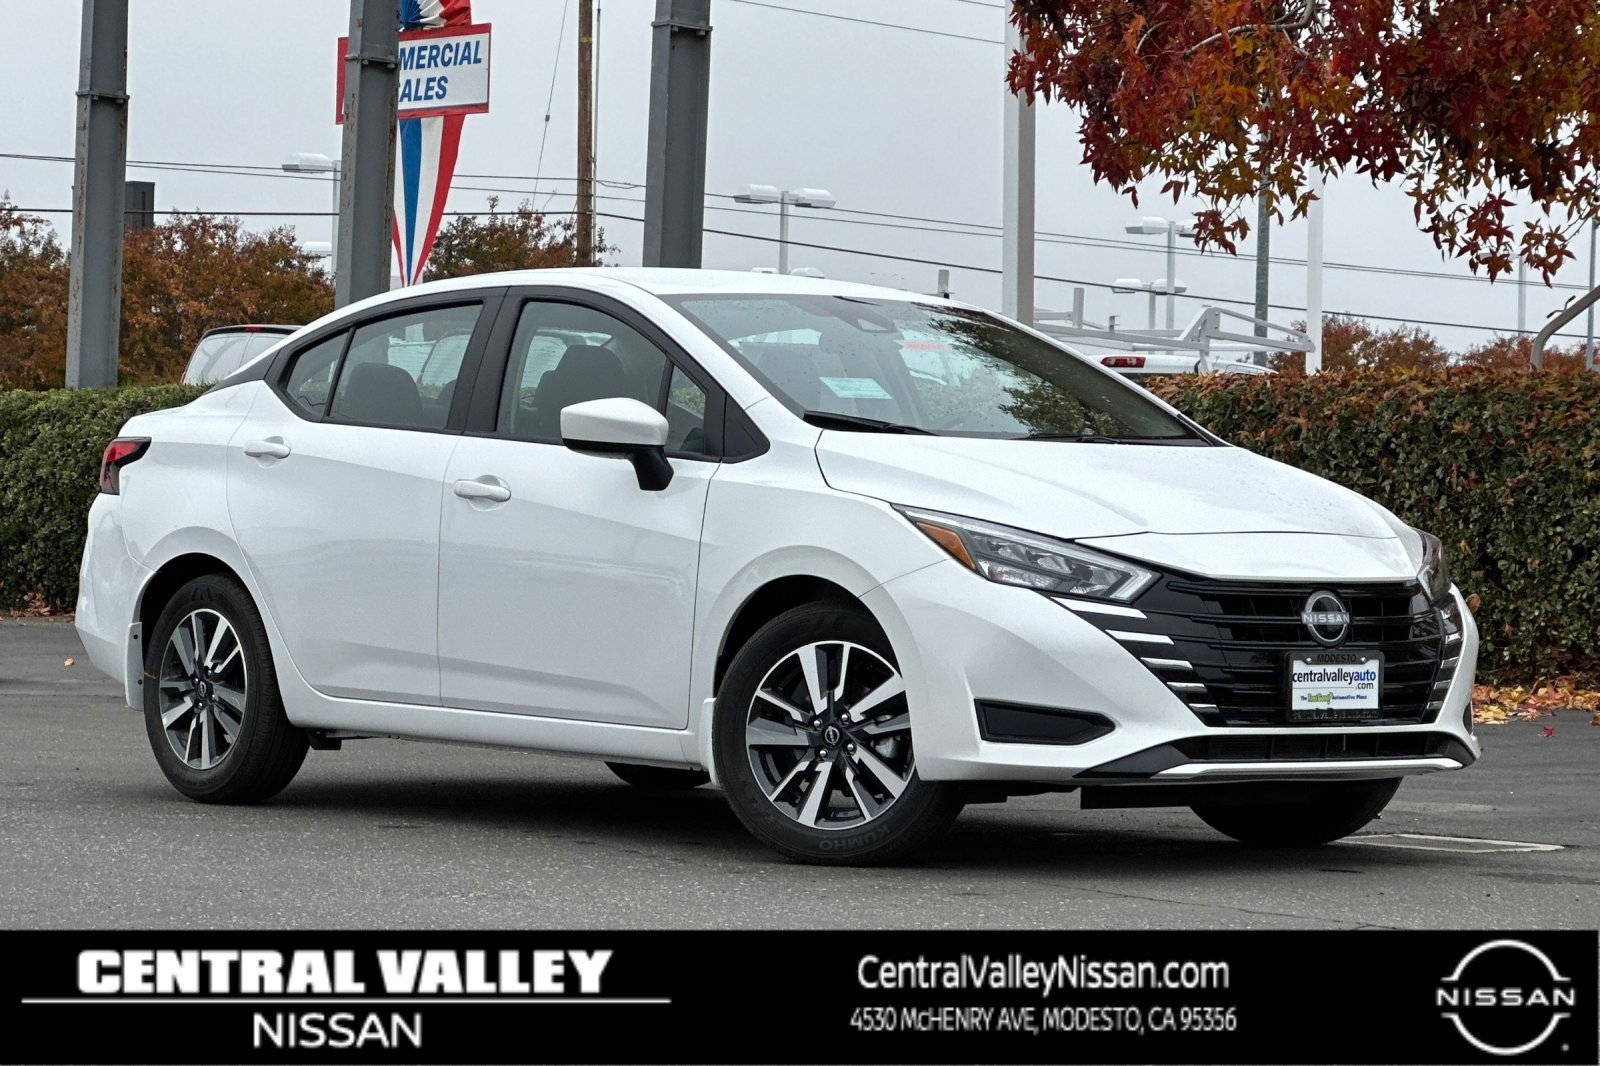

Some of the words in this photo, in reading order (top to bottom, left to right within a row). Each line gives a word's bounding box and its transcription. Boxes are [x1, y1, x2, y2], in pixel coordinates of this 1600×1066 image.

[399, 40, 482, 70] MERCIAL
[399, 76, 448, 103] ALES
[1302, 613, 1350, 624] NISSAN
[1316, 654, 1357, 663] MODESTO
[1292, 668, 1377, 685] centralvalleyauto
[818, 825, 889, 851] KUMHO
